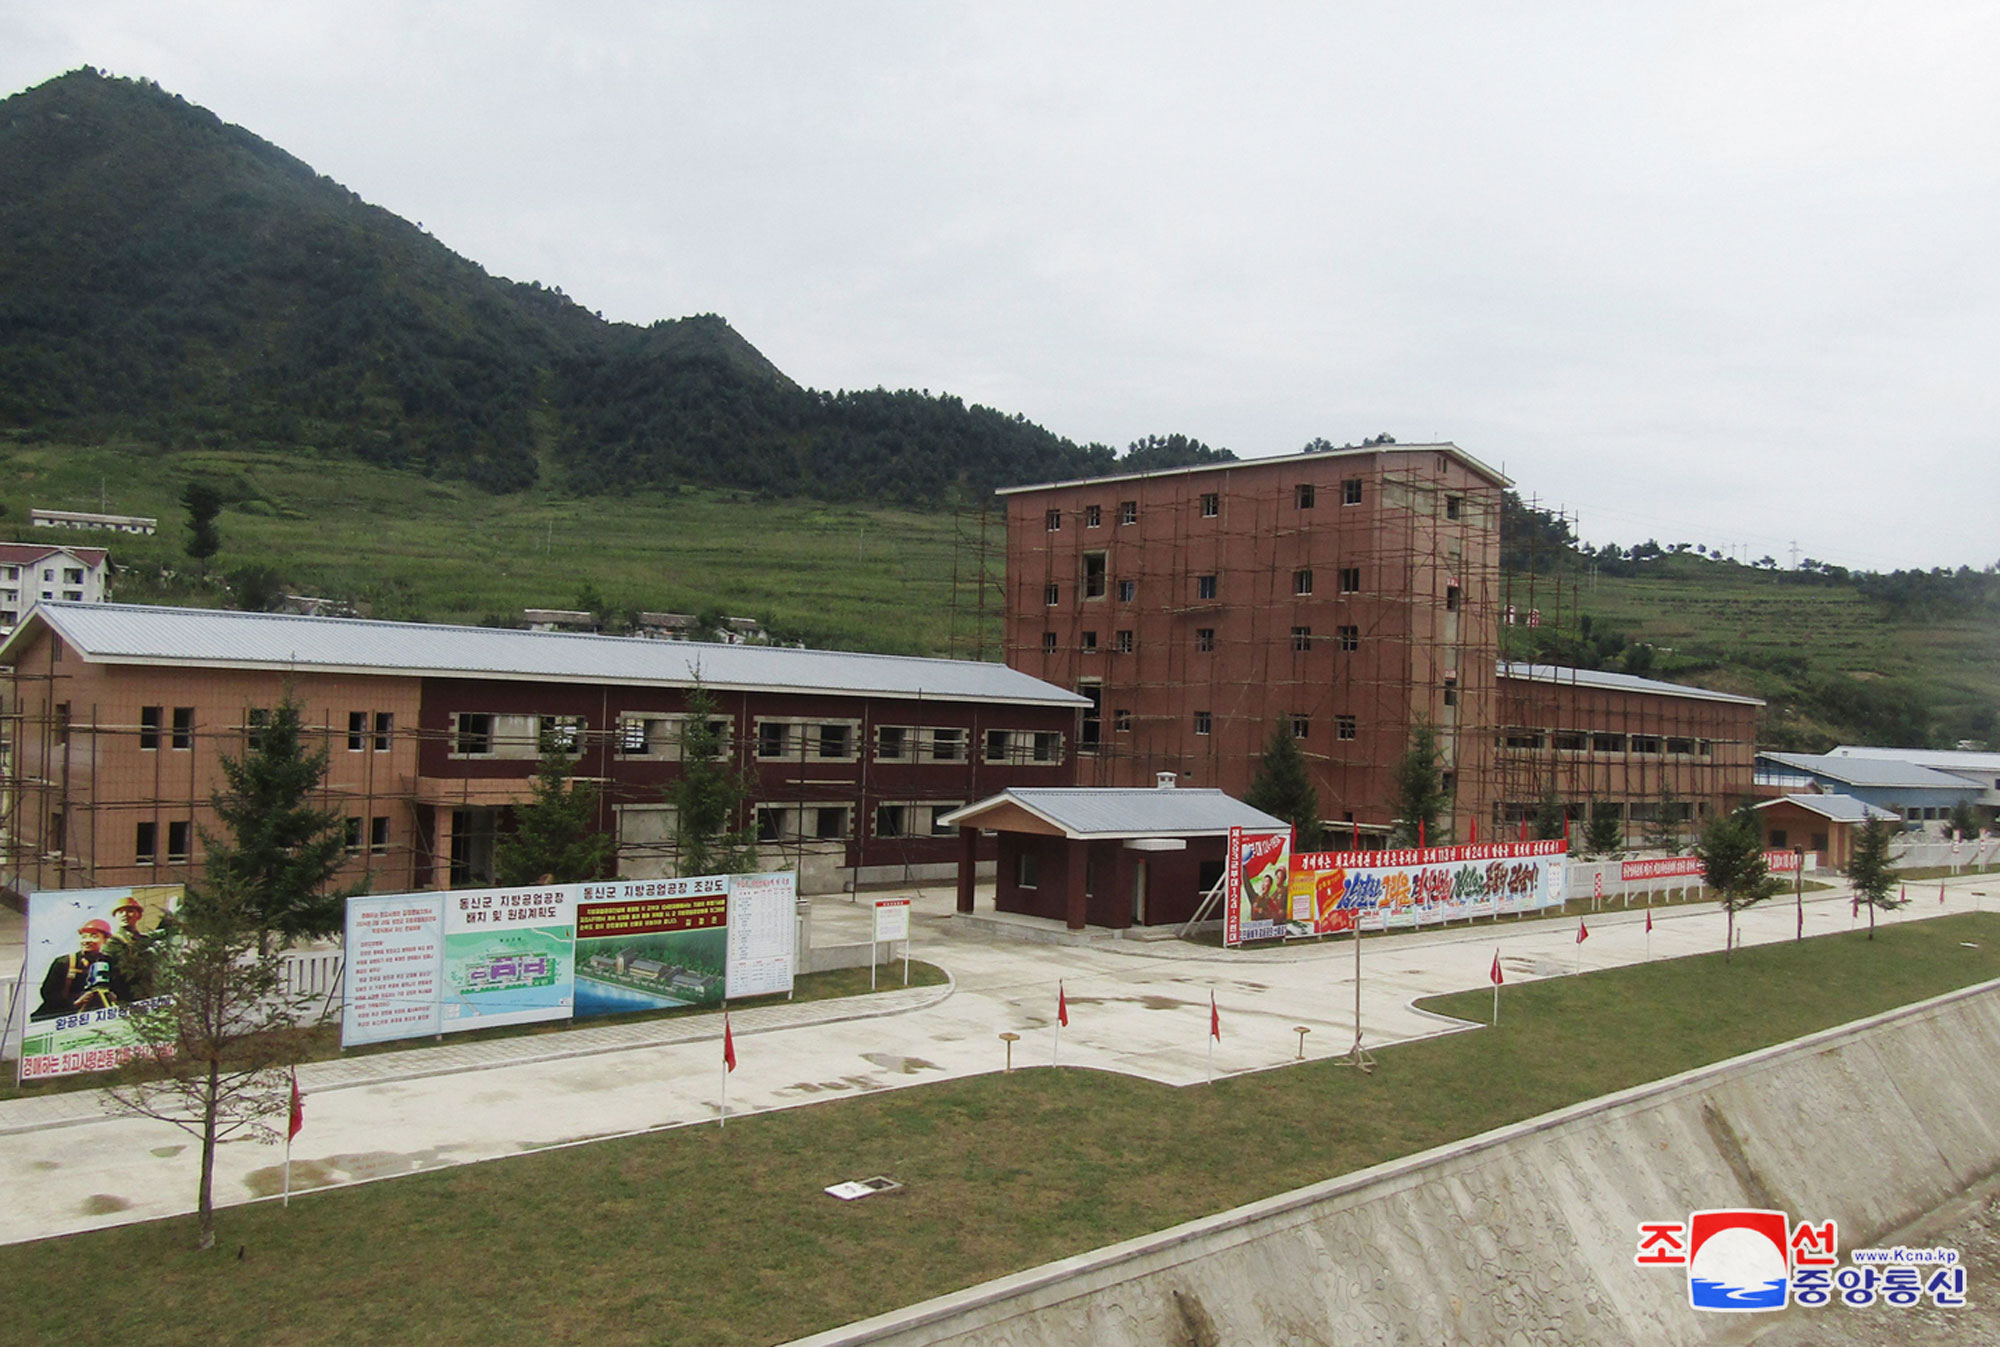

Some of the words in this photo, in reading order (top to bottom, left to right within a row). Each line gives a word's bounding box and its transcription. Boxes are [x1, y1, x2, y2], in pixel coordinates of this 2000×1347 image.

[584, 886, 616, 899] 동신군
[624, 882, 687, 897] 지방공업공장
[694, 880, 723, 893] 조감도
[460, 896, 492, 910] 동신군
[501, 892, 564, 906] 지방공업공장
[466, 911, 487, 923] 배치
[493, 910, 502, 922] 및
[56, 1013, 89, 1031] 완공된
